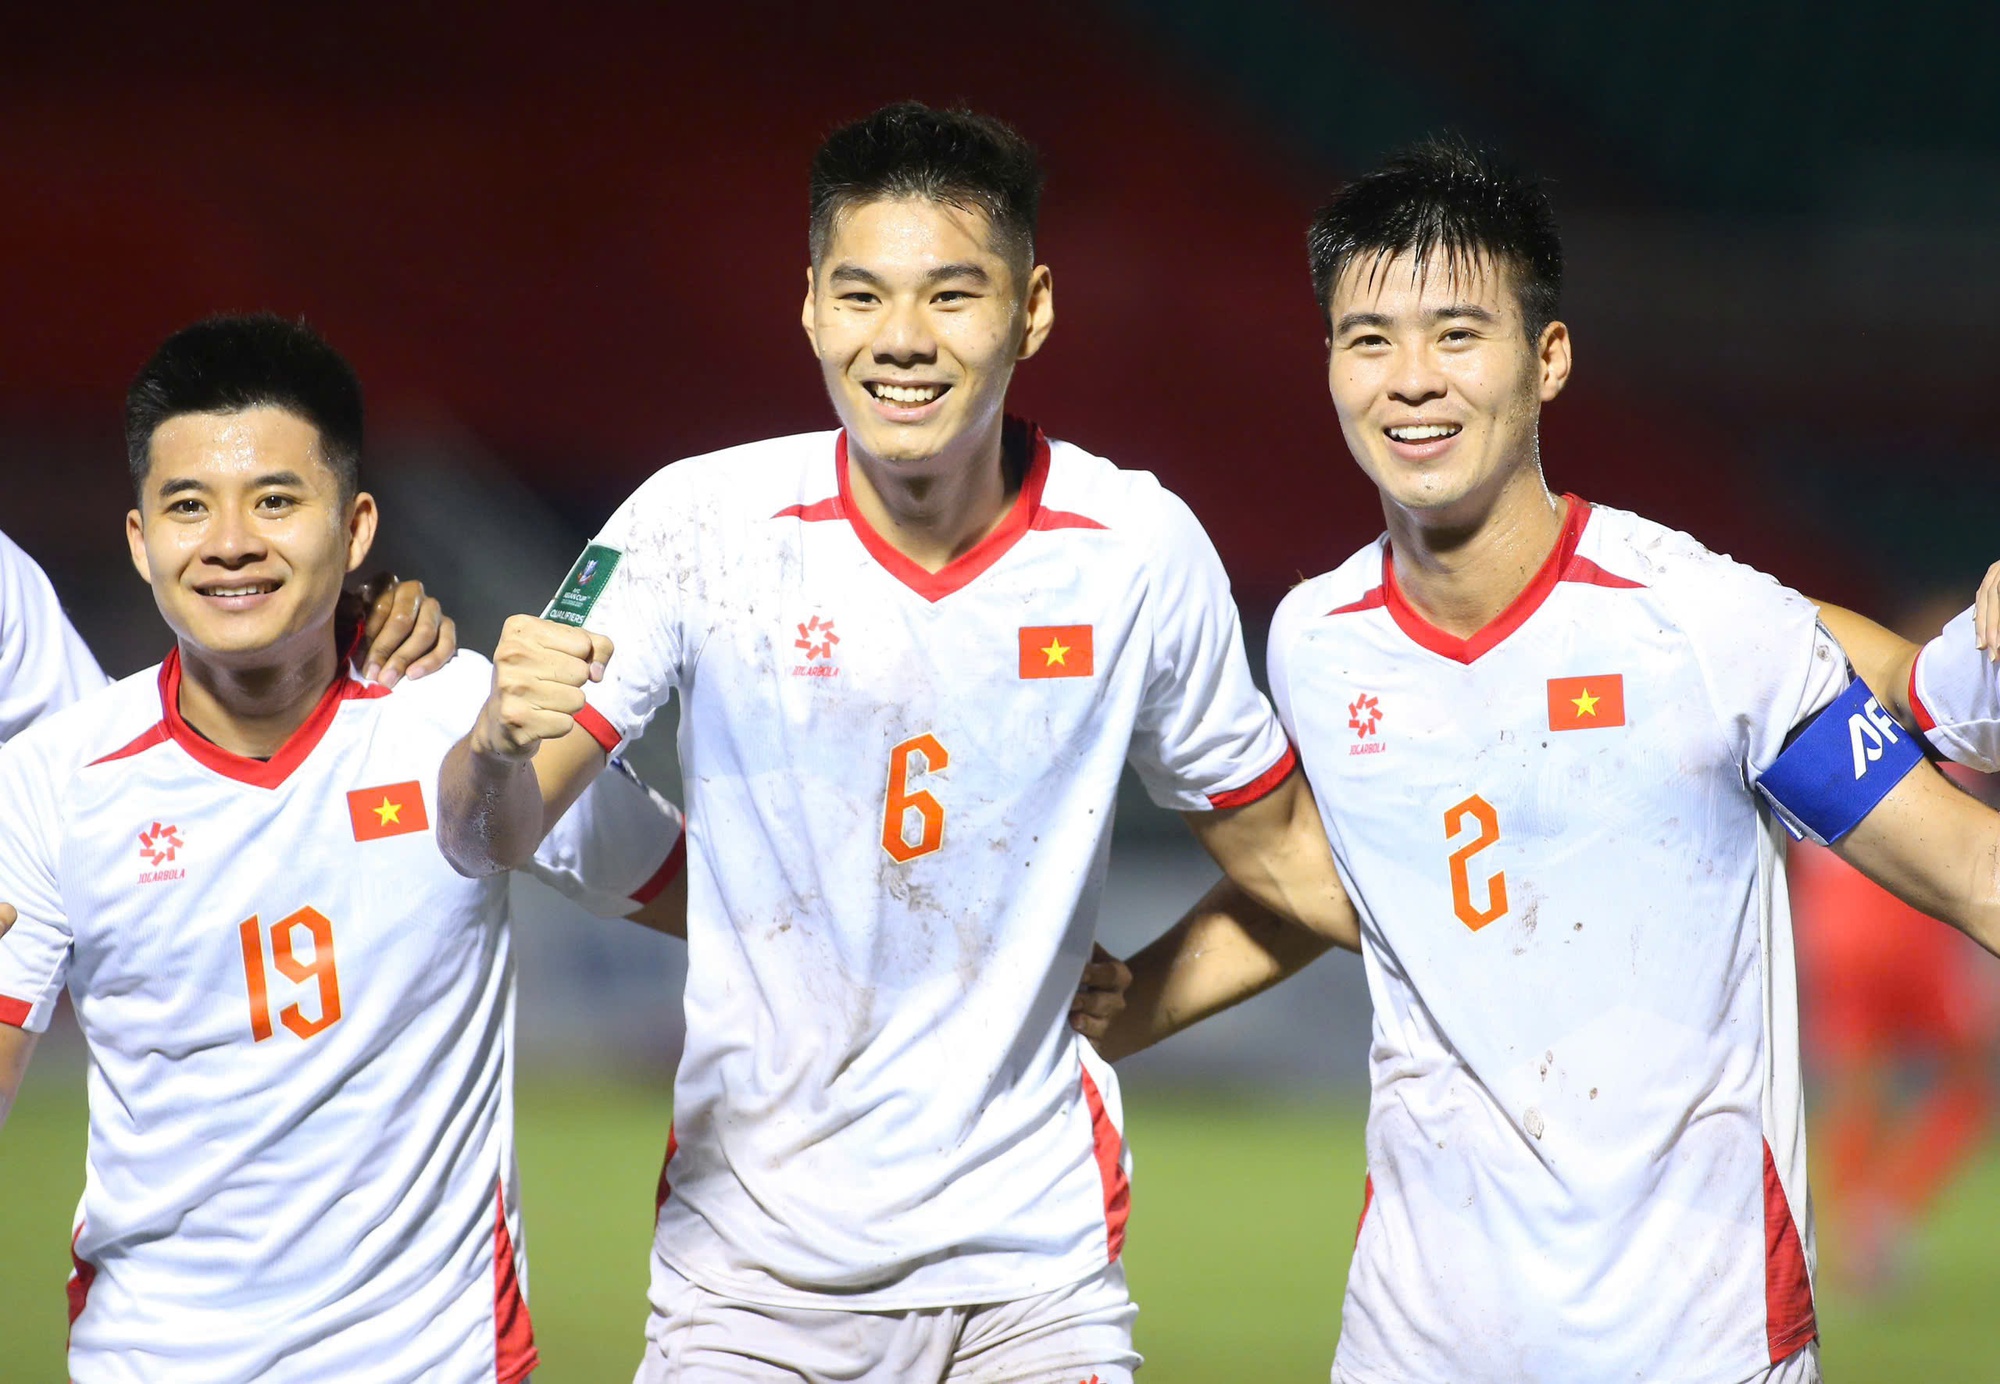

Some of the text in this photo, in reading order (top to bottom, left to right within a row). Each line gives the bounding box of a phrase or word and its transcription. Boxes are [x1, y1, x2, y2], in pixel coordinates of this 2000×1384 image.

[550, 609, 585, 624] QUALIFIERS
[1848, 696, 1905, 780] AF
[880, 731, 950, 864] 6
[137, 868, 186, 884] JOGARBOLA
[1443, 792, 1509, 932] 2
[238, 904, 343, 1043] 19
